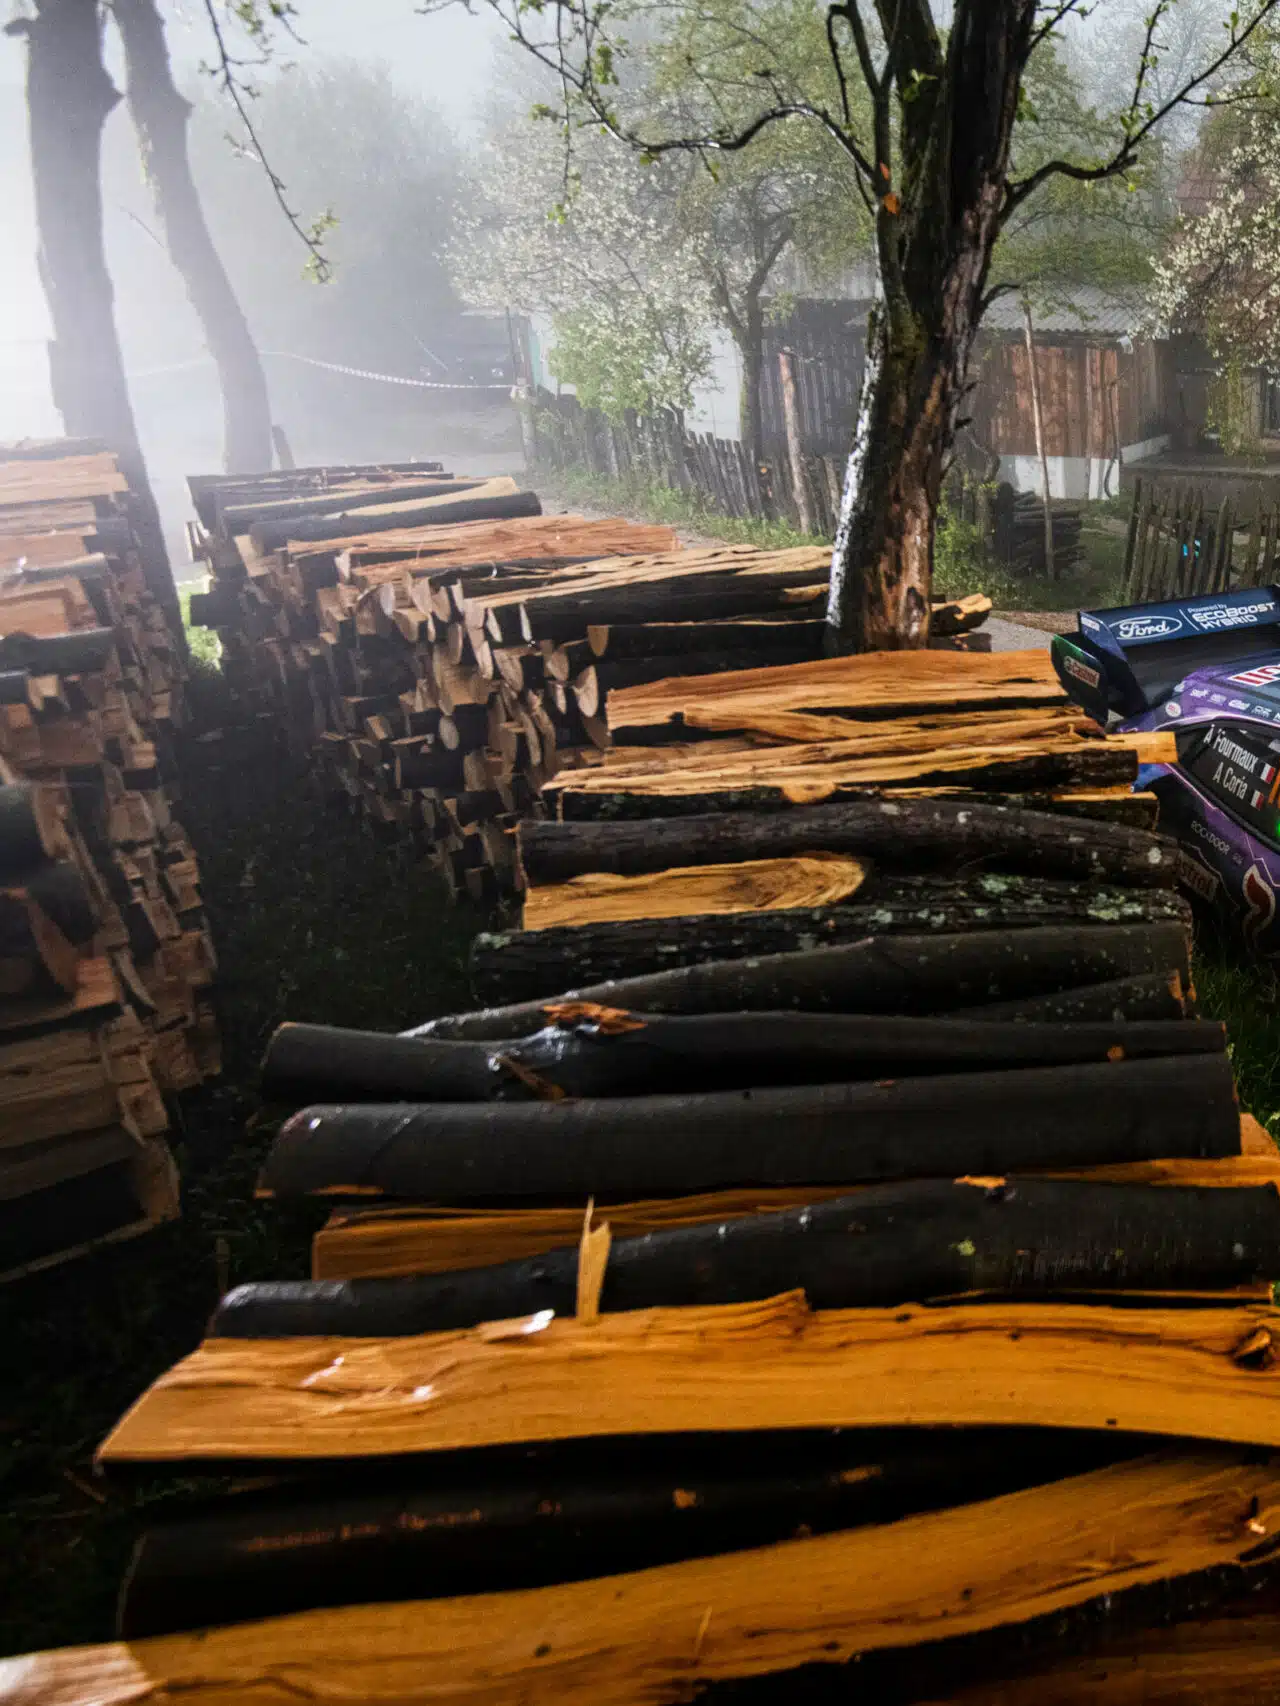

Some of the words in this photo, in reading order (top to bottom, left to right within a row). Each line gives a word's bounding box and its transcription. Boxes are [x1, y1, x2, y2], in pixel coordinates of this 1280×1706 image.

[1119, 620, 1170, 638] Ford
[1200, 615, 1258, 629] HYBRID
[1203, 723, 1216, 744] A
[1213, 762, 1224, 783] A
[1223, 767, 1248, 800] Coria
